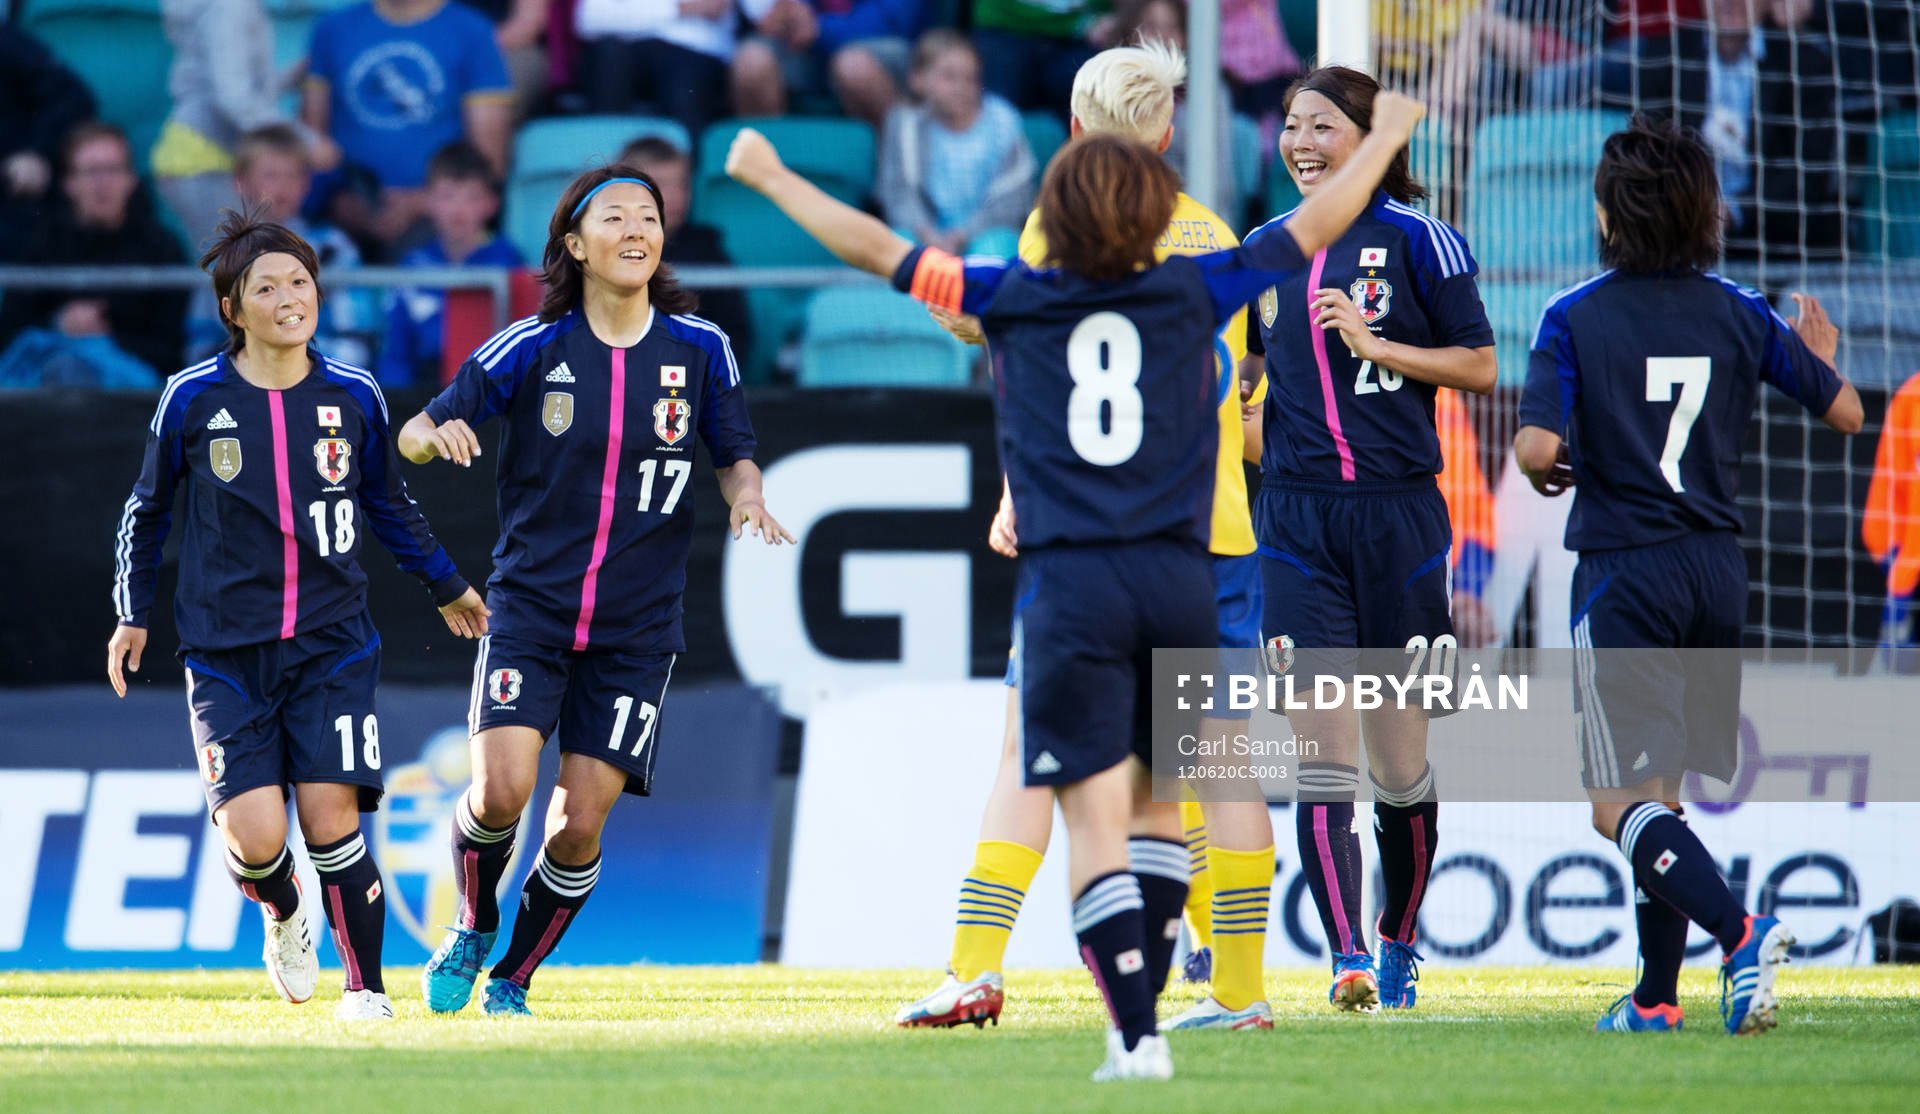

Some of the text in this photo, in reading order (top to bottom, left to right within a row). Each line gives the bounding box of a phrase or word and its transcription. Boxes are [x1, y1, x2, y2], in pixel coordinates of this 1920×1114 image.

[545, 374, 576, 384] adidas
[1067, 311, 1144, 467] 8
[207, 420, 238, 430] adidas
[1645, 356, 1711, 493] 7
[637, 459, 692, 515] 17
[309, 498, 356, 557] 18
[722, 442, 971, 720] G
[1404, 633, 1458, 690] 20
[335, 714, 382, 771] 18
[608, 695, 657, 757] 17
